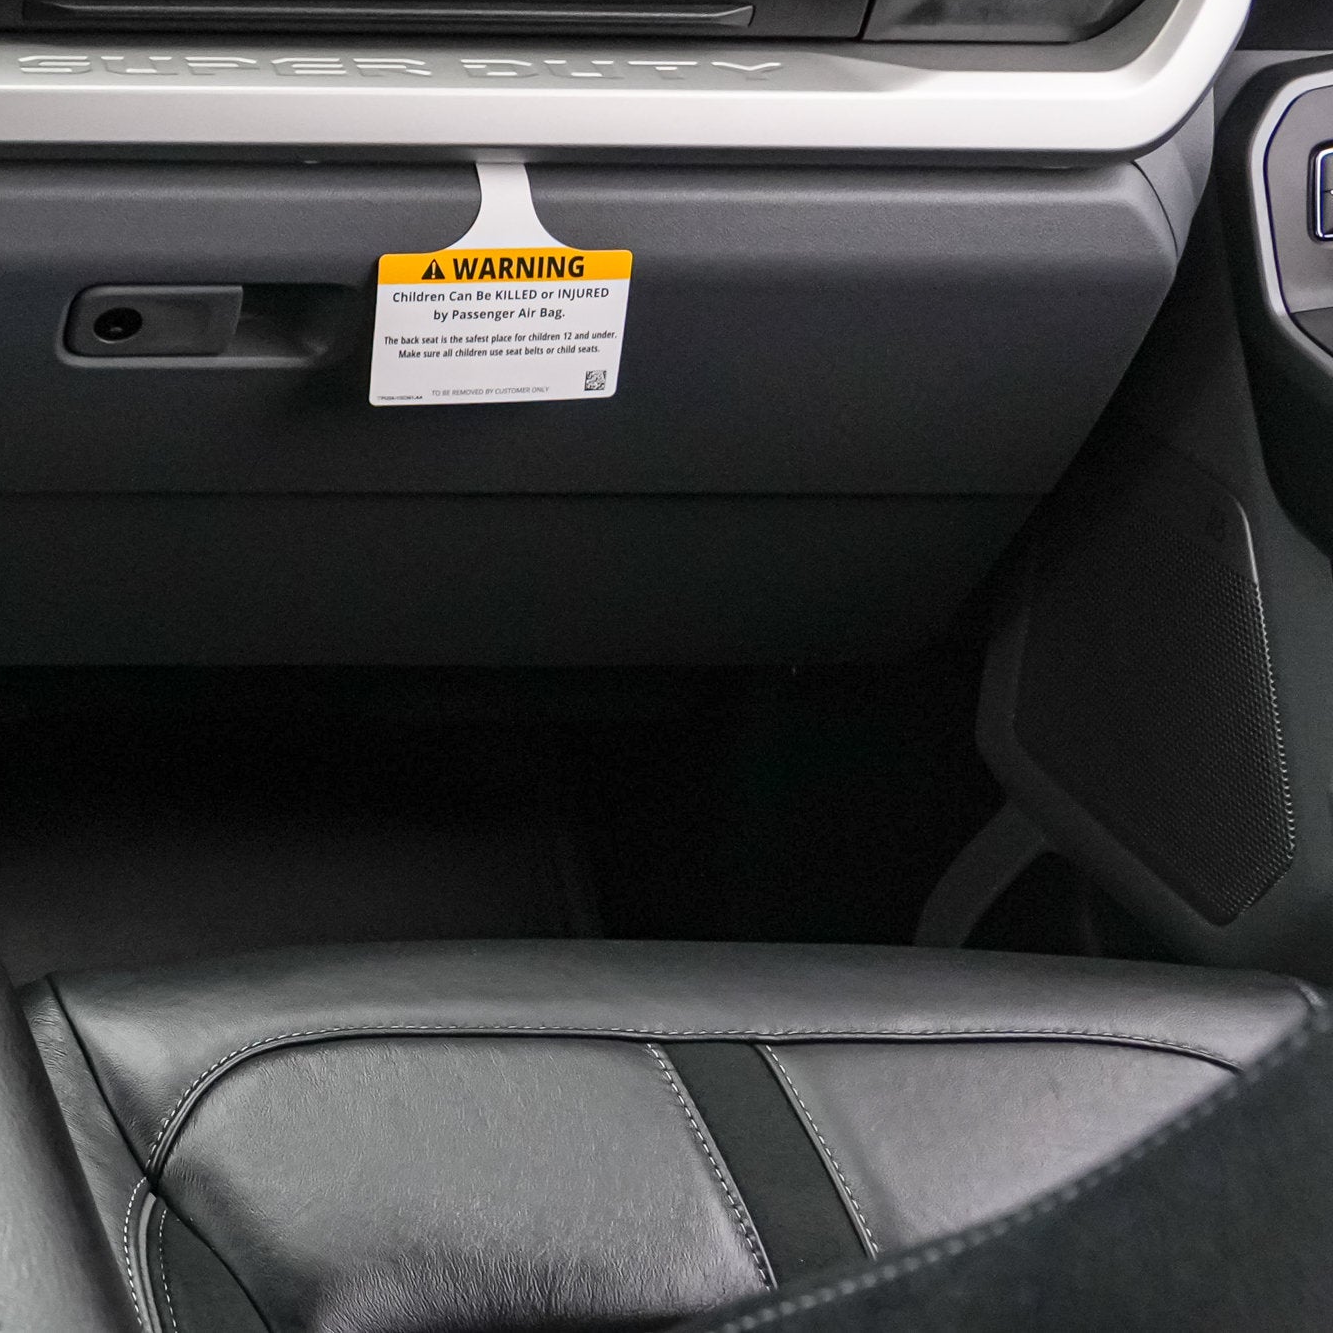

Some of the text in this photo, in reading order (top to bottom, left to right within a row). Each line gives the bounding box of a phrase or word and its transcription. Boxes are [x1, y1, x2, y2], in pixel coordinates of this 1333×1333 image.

[18, 55, 783, 82] SUPER DUTY
[453, 255, 585, 281] WARNING
[392, 287, 610, 303] Children Can Be KILLED or INJURED
[433, 307, 566, 323] by Passenger Air Bag.
[384, 329, 618, 346] The back seat is the safest place for children 12 and under.
[398, 344, 600, 359] Make sure all children use seat belts or child seats.
[451, 388, 484, 396] REMOVED
[494, 387, 531, 395] CUSTOMER
[532, 386, 550, 394] ONLY
